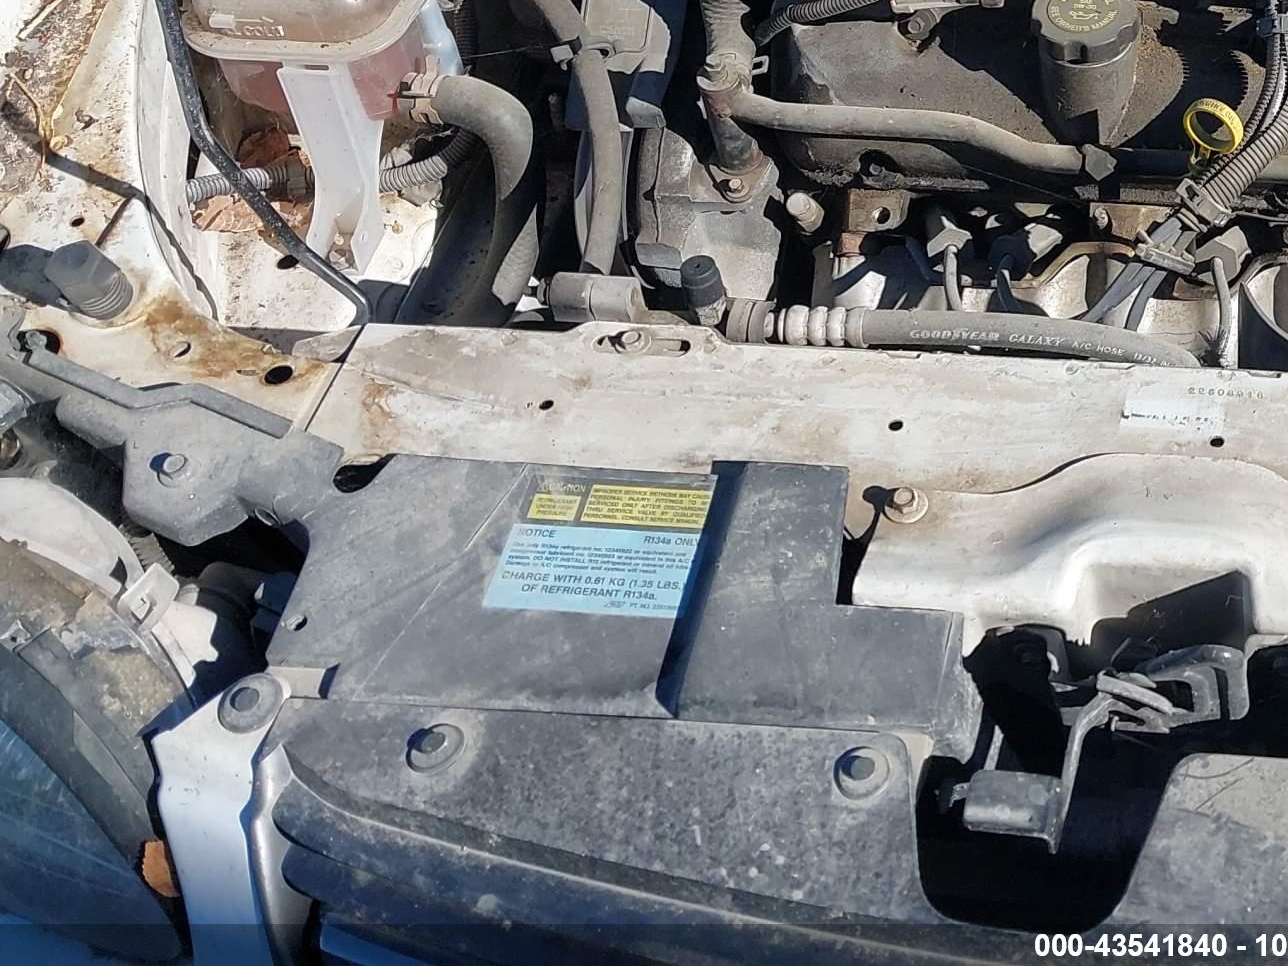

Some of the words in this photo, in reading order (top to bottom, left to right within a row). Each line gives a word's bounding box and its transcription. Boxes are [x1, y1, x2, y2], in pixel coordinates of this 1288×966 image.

[1051, 5, 1060, 18] SEE
[1091, 9, 1118, 30] MANUAL
[910, 329, 1000, 341] GOODYEAR
[1009, 333, 1065, 347] GALAXY
[1072, 341, 1092, 351] A/C
[1096, 345, 1127, 355] HOSE
[644, 535, 671, 545] R134a
[553, 563, 589, 571] compressor
[501, 570, 551, 582] CHARGE
[553, 574, 583, 584] WITH
[584, 576, 605, 585] 0.61
[608, 577, 626, 587] KG
[629, 579, 654, 589] (1.35
[521, 583, 538, 592] OF
[541, 584, 621, 597] REFRIGERANT
[623, 590, 657, 600] R134a.
